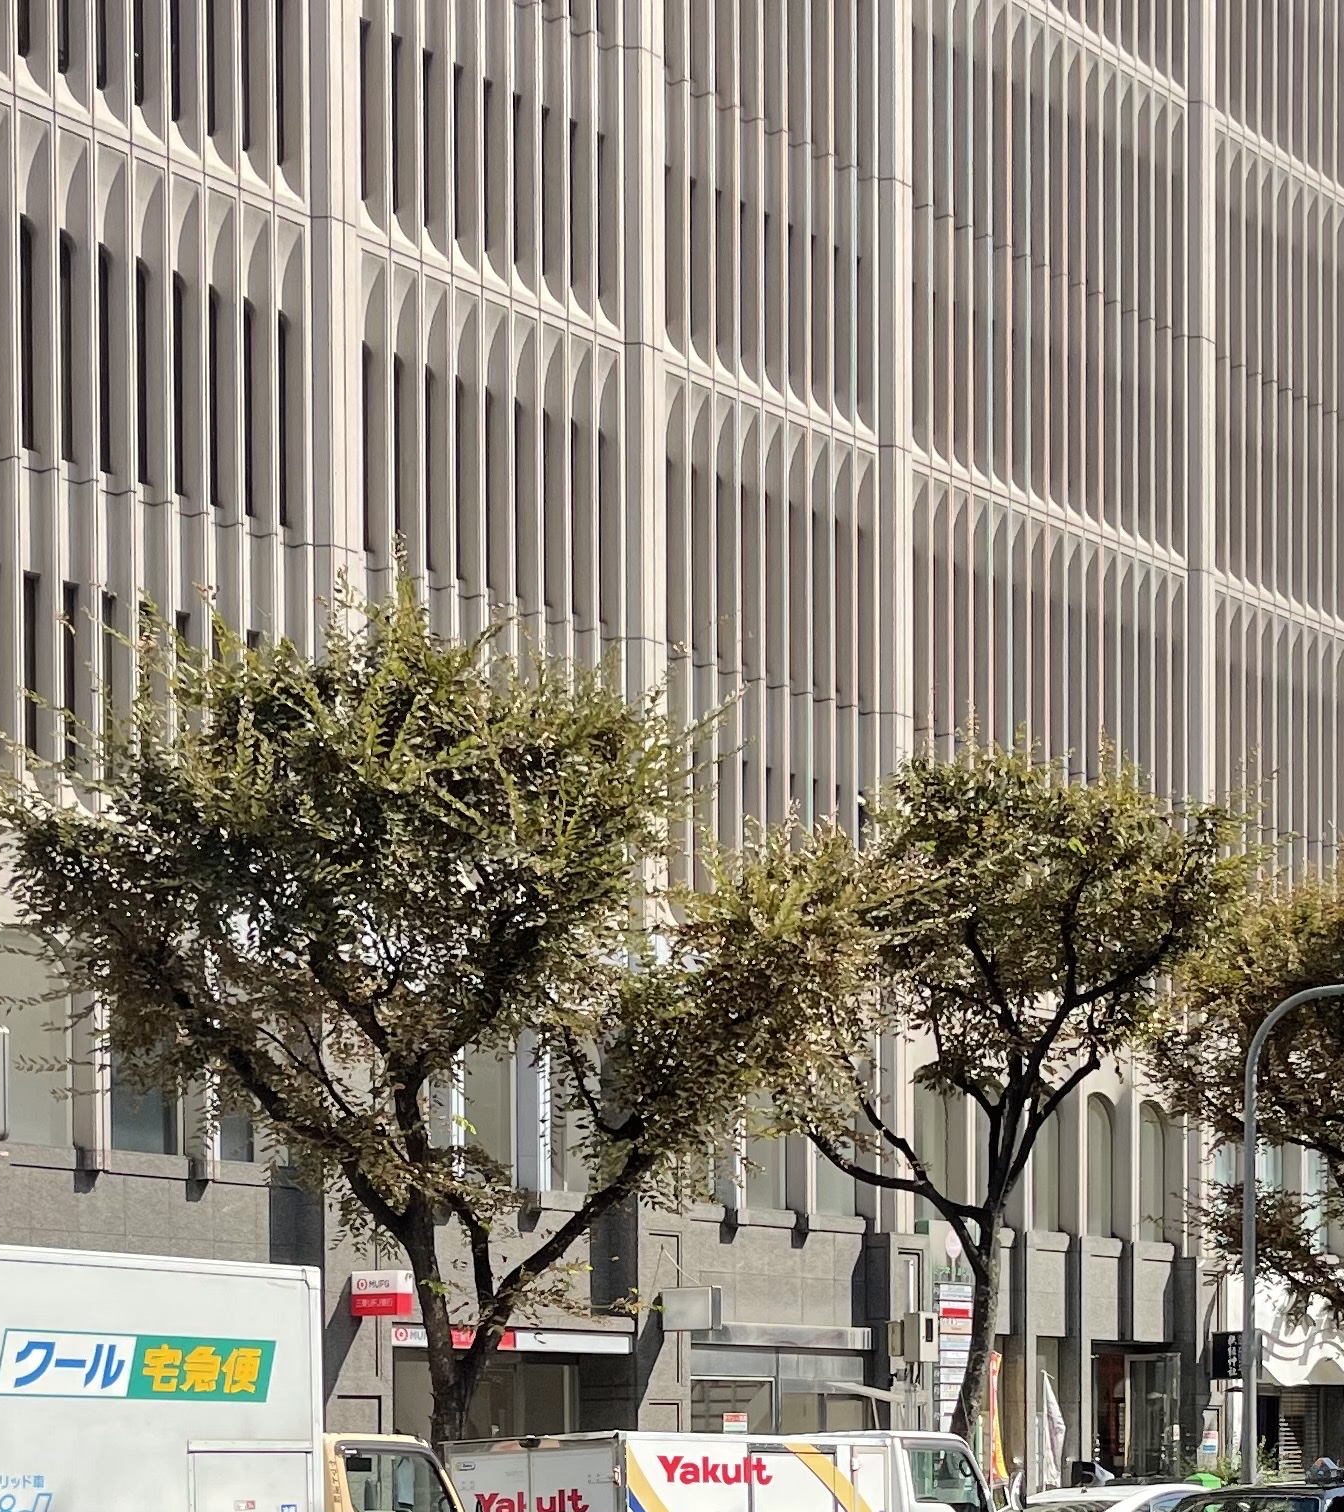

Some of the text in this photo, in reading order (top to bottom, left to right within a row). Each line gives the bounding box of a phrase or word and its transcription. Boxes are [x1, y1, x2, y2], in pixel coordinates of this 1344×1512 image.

[368, 1280, 390, 1289] MUFG
[409, 1329, 427, 1341] MUF
[13, 1340, 263, 1394] クール 宅急便
[655, 1455, 773, 1486] Yakult
